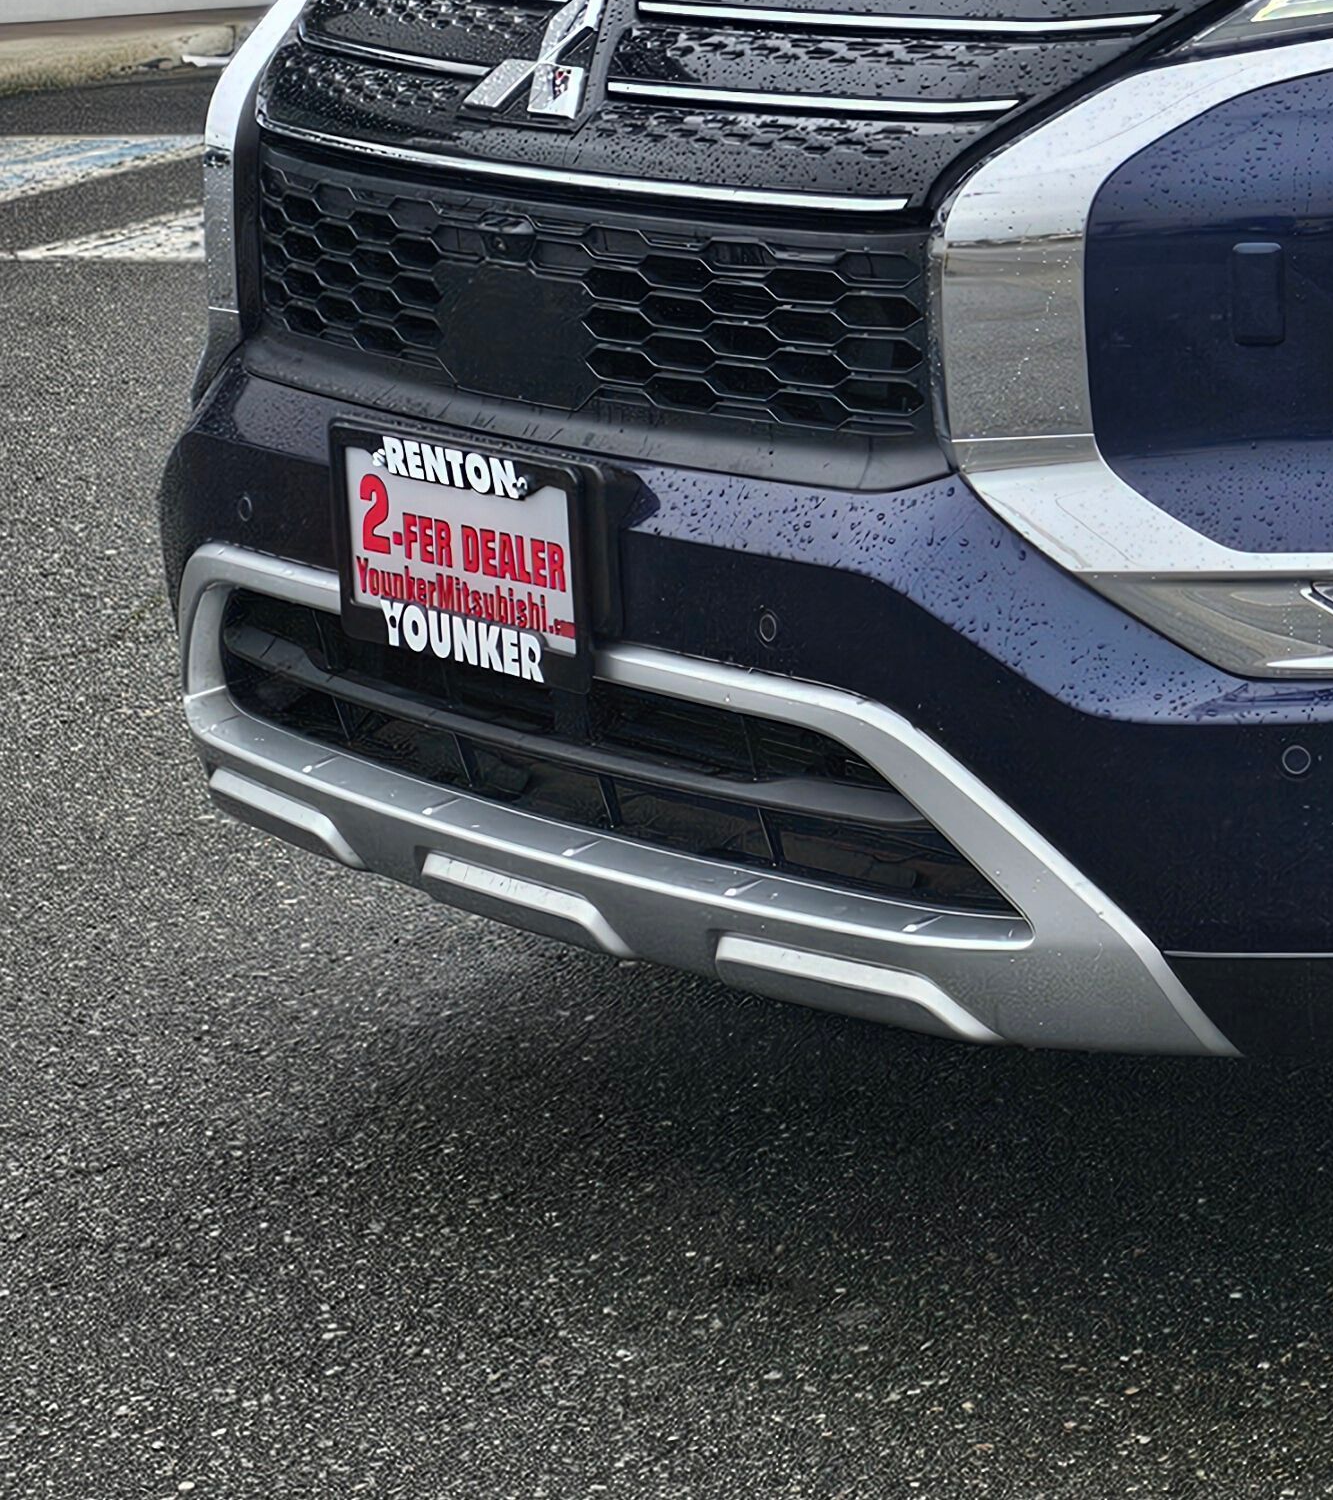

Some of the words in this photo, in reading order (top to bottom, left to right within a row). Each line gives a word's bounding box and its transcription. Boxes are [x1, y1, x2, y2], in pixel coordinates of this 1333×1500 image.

[382, 435, 520, 500] RENTON
[359, 473, 453, 569] 2-FER
[460, 523, 567, 593] DEALER
[380, 598, 545, 684] YOUNKER
